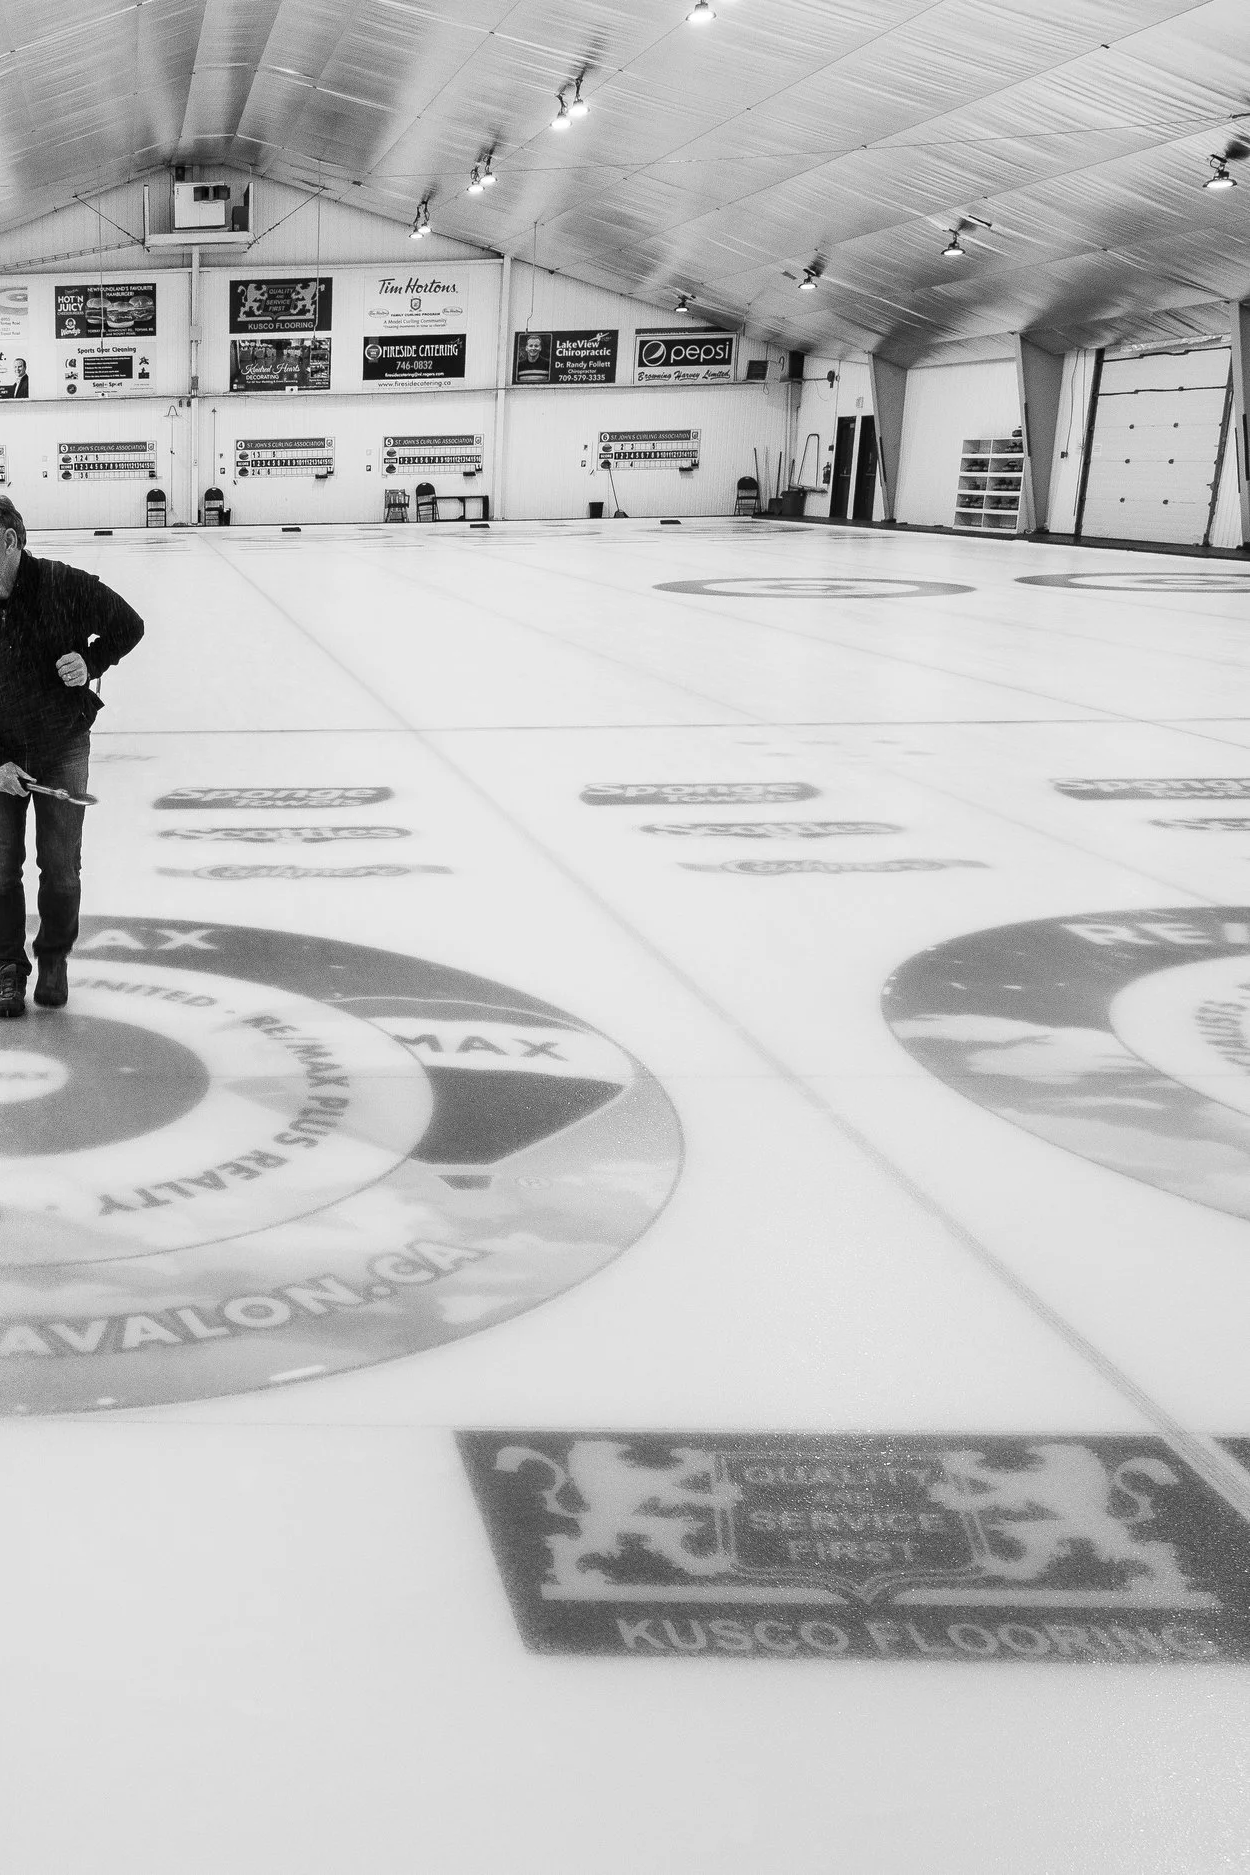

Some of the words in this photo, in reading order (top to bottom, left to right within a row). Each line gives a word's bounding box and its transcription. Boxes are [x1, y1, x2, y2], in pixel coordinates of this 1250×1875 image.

[378, 278, 402, 294] Tim
[382, 345, 416, 358] FIRESIDE
[419, 344, 458, 357] CATERING
[556, 340, 600, 348] LakeView
[556, 348, 611, 357] Chiropractic
[670, 342, 729, 363] pepsi
[396, 361, 432, 370] 746-0832
[638, 372, 671, 381] Browning
[674, 370, 700, 381] Harvey
[702, 369, 730, 380] Limited
[168, 787, 377, 802] Sponge
[586, 783, 801, 796] Sponge
[235, 798, 362, 806] Towels
[392, 1032, 576, 1063] MAX
[272, 1093, 349, 1150] PLUS
[97, 1152, 290, 1217] REALTY
[748, 1508, 944, 1532] SERVICE
[787, 1538, 920, 1562] FIRST
[615, 1616, 851, 1656] KUSCO
[870, 1620, 1220, 1658] FLOORING
